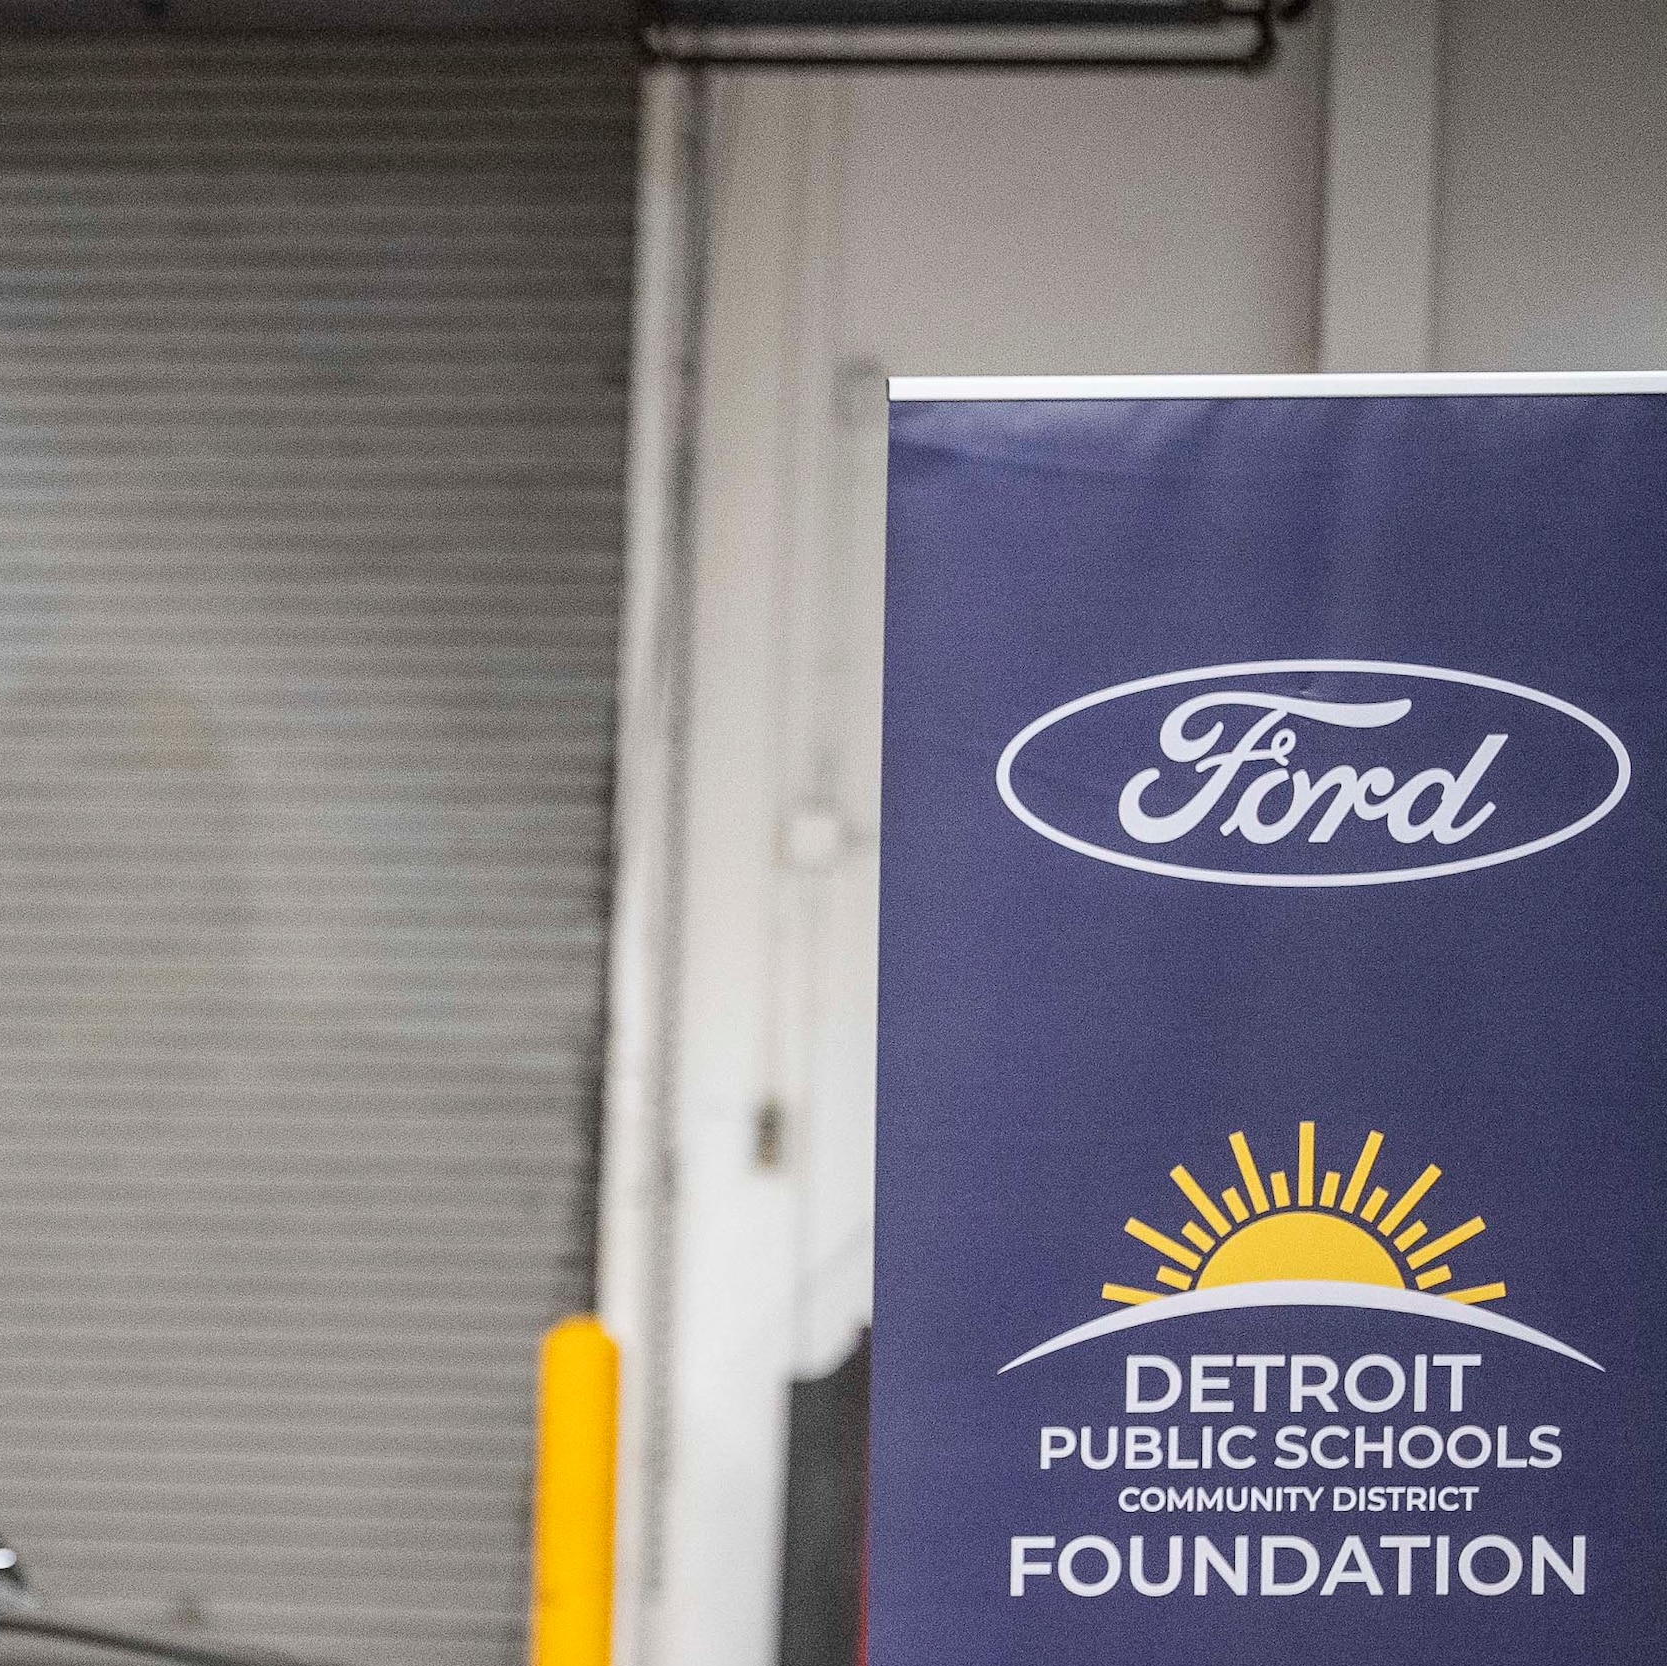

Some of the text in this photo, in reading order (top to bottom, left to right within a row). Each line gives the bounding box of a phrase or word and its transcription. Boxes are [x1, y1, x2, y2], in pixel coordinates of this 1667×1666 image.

[1118, 689, 1511, 846] Ford
[1125, 1353, 1482, 1414] DETROIT
[1040, 1424, 1563, 1470] PUBLIC SCHOOLS
[1118, 1486, 1480, 1513] COMMUNITY DISTRICT
[1008, 1533, 1587, 1598] FOUNDATION
